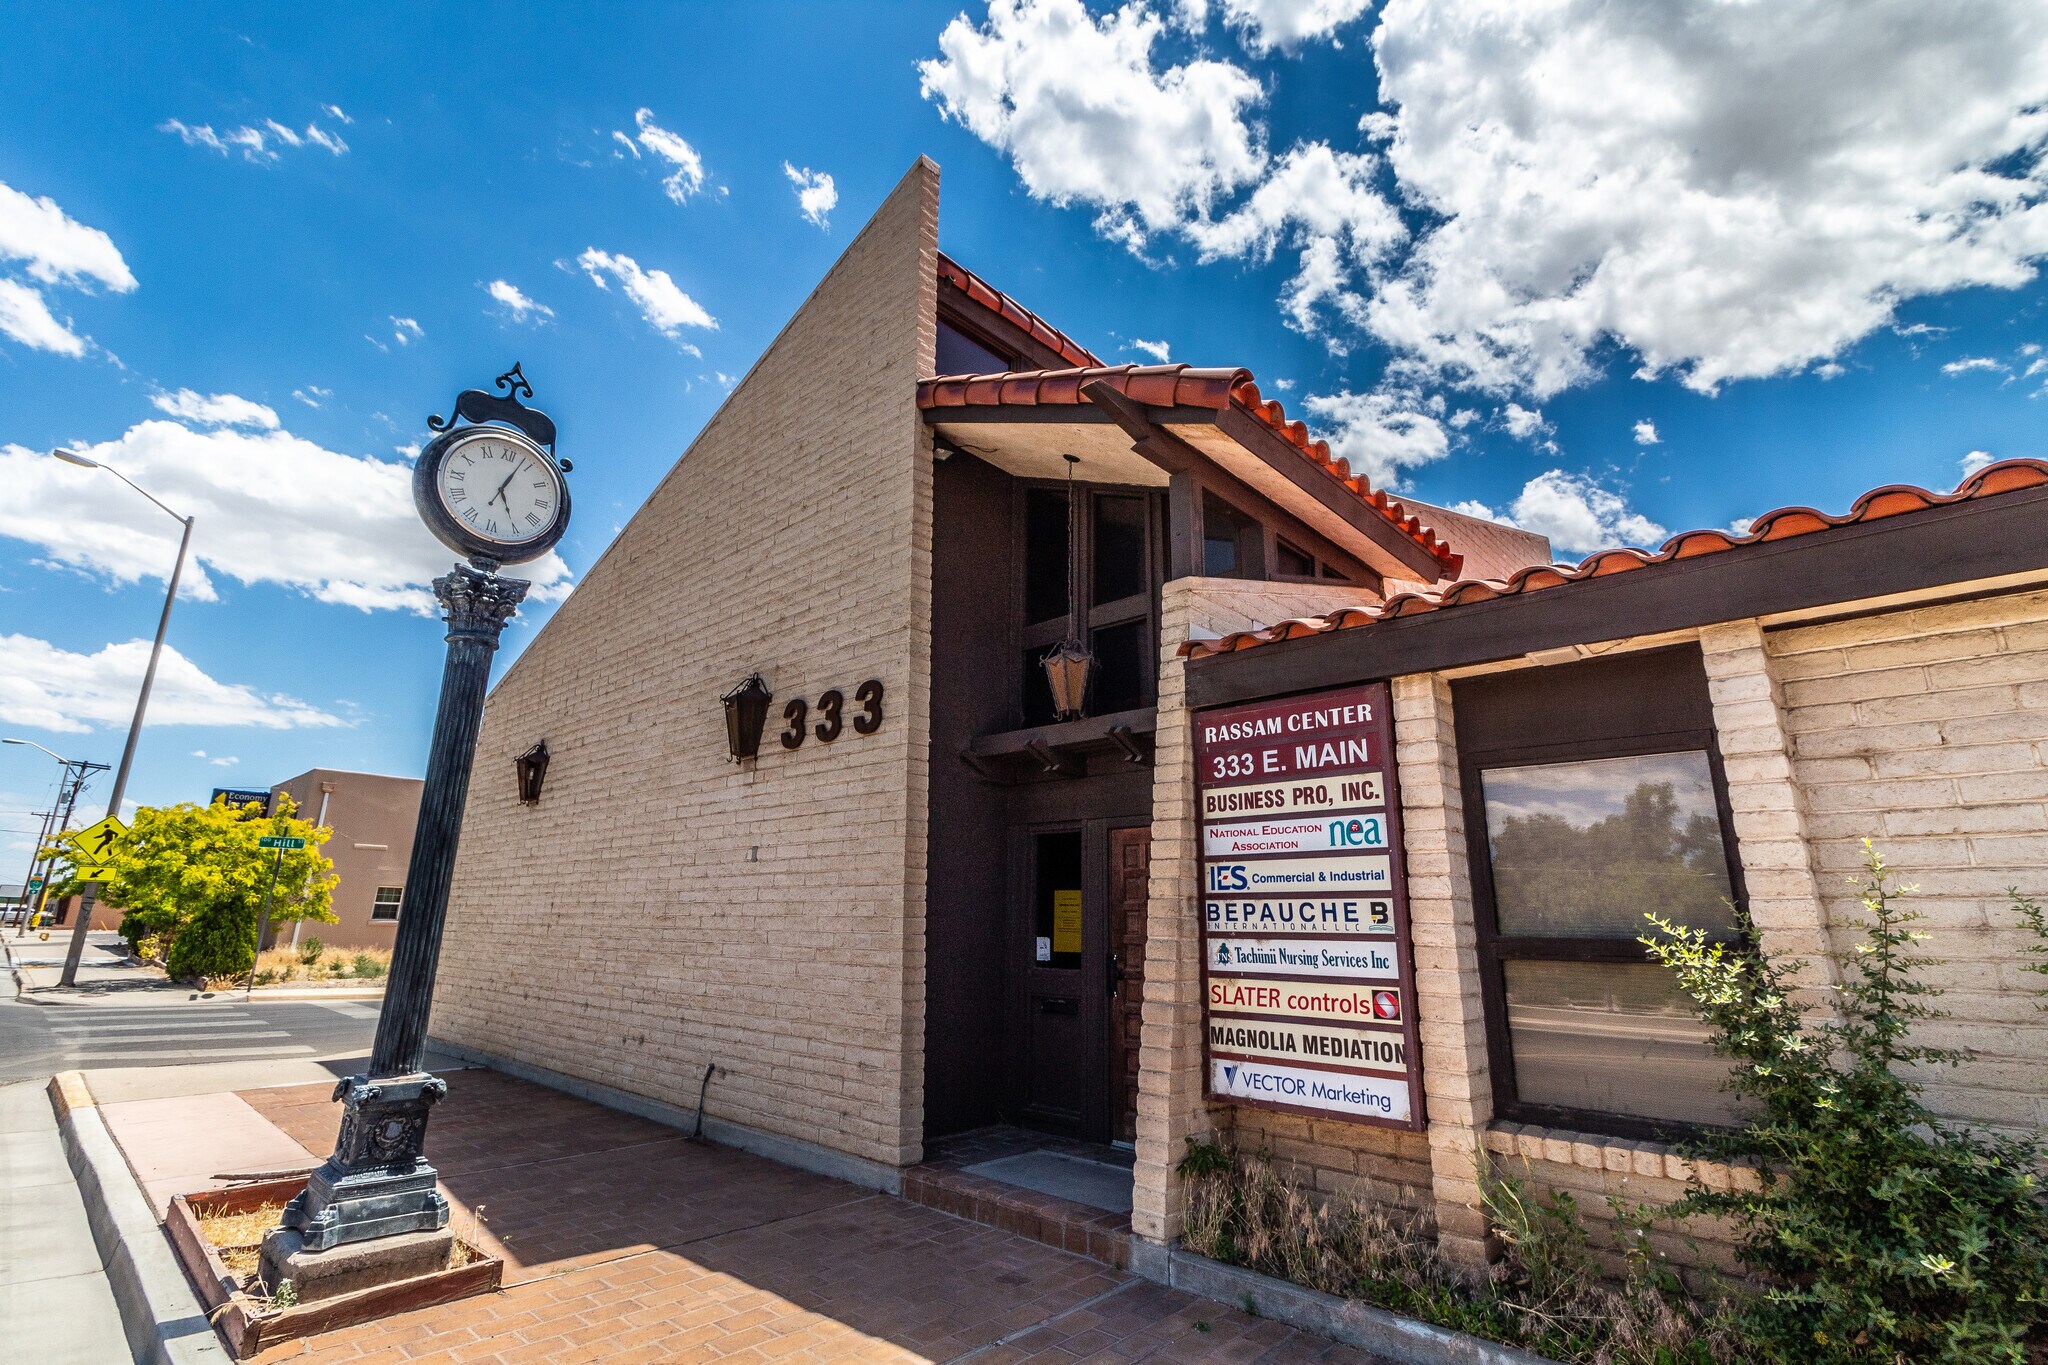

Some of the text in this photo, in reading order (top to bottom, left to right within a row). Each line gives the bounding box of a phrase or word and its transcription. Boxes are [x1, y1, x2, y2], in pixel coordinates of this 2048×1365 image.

[781, 680, 884, 750] 333
[1205, 703, 1373, 744] RASSAM CENTER
[1213, 738, 1369, 779] 333 E. MAIN
[228, 791, 268, 803] Economy
[1206, 780, 1380, 813] BUSINESS PRO, INC.
[273, 838, 295, 848] Hill
[1209, 824, 1322, 839] NATIONAL EDUCATION
[1328, 818, 1382, 847] nea
[1231, 840, 1299, 851] ASSOCIATION
[1210, 865, 1385, 891] IES Commercial & Industrial
[1206, 902, 1360, 923] BEPAUCHE
[1206, 922, 1360, 932] INTERNATIONAL LLC
[1234, 946, 1277, 965] Tachiinii
[1279, 947, 1319, 969] Nursing
[1321, 950, 1368, 969] Services
[1371, 950, 1390, 970] Inc
[1211, 984, 1371, 1015] SLATER controls
[1210, 1025, 1406, 1065] MAGNOLIA MEDIATION
[1242, 1071, 1392, 1113] VECTOR Marketing
